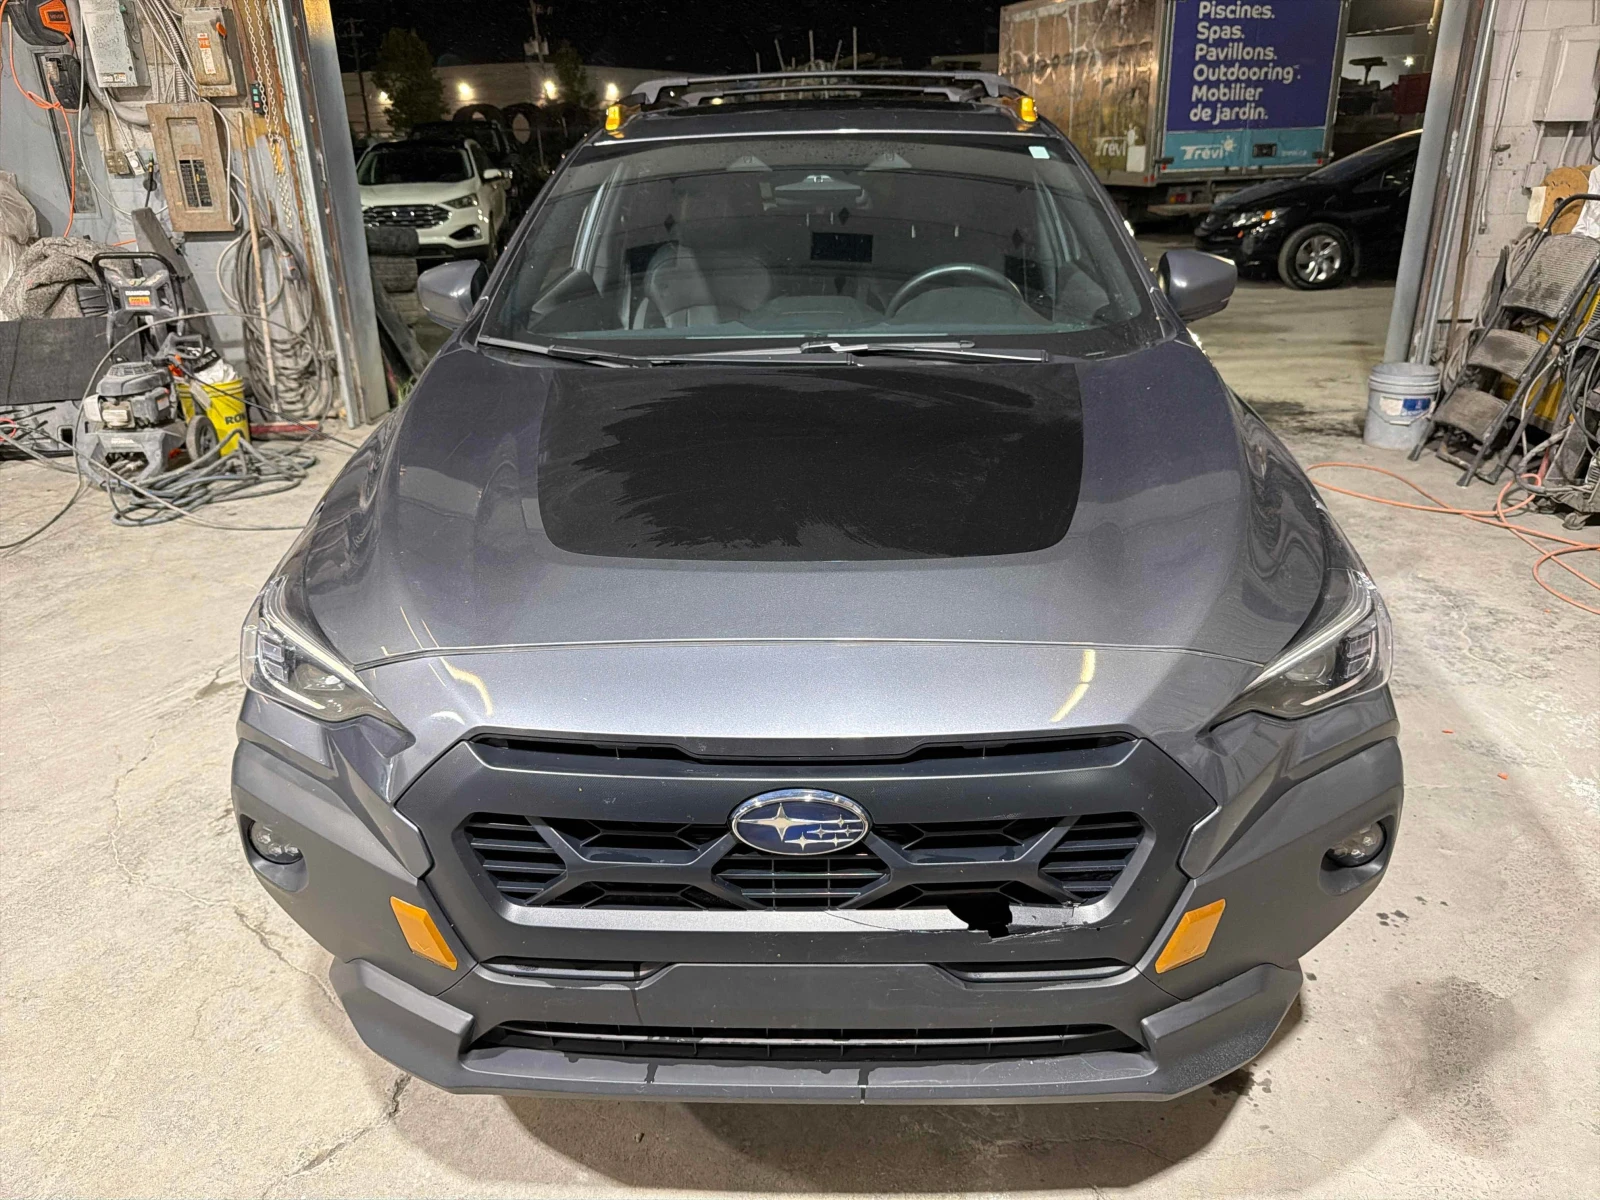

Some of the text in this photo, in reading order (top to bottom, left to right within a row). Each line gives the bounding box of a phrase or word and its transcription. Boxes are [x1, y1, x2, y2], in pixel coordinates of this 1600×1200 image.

[1198, 1, 1275, 19] Piscines.
[1197, 22, 1245, 43] Spas.
[1195, 43, 1278, 61] Pavillons.
[1191, 84, 1263, 102] Mobilier
[1189, 103, 1268, 125] de jardin.
